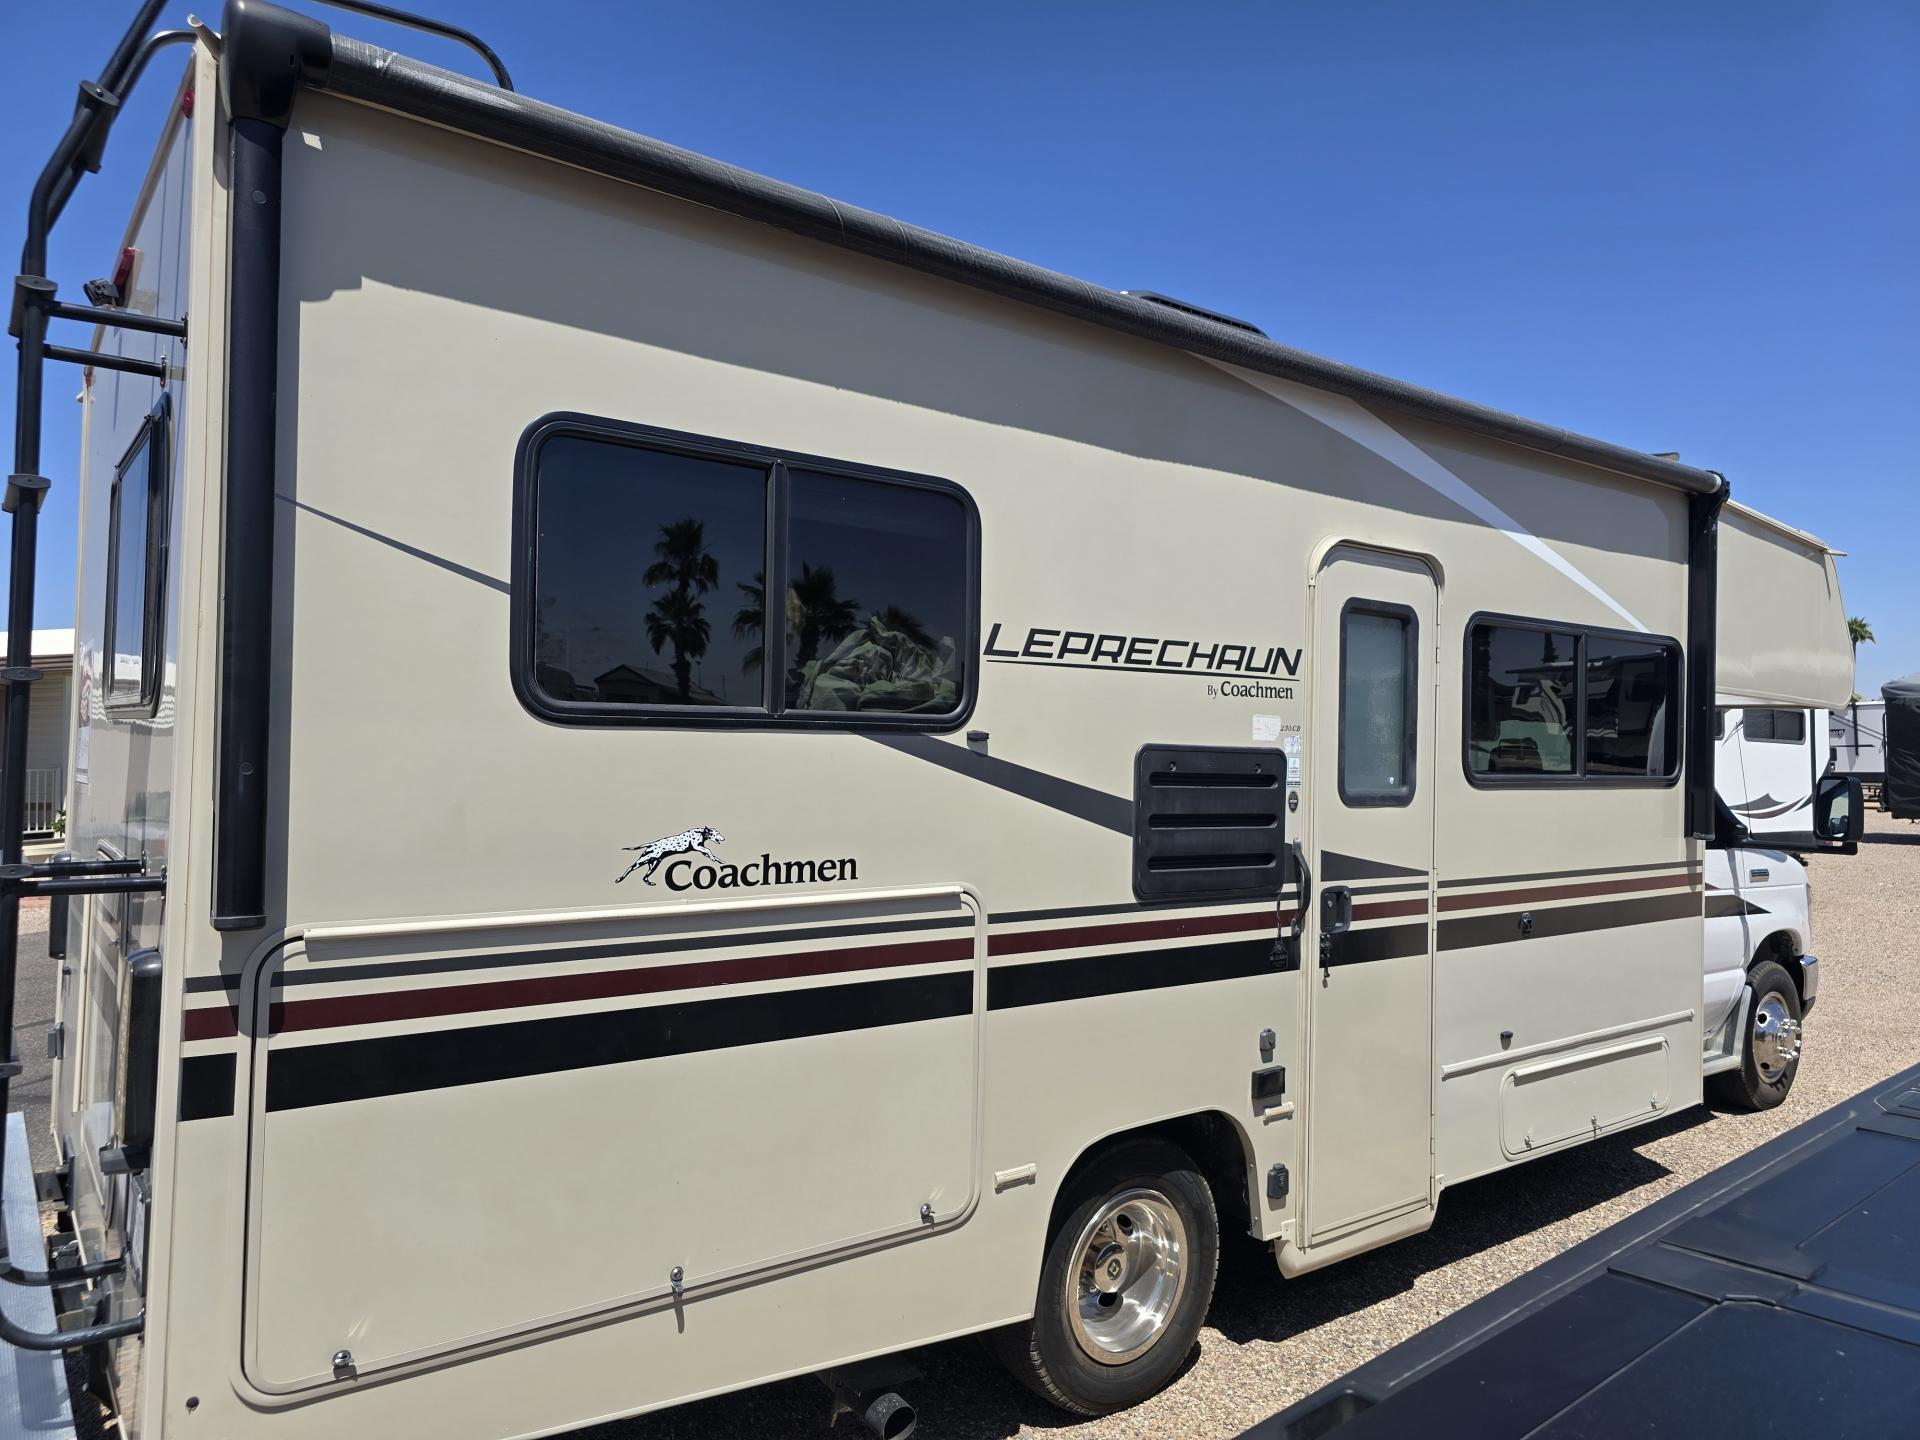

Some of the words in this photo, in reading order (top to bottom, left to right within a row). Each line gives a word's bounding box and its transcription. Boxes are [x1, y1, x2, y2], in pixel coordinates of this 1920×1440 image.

[982, 622, 1303, 676] LEPRECHAUN
[1207, 684, 1219, 700] By
[1220, 681, 1294, 700] Coachmen
[665, 853, 859, 891] Coachmen
